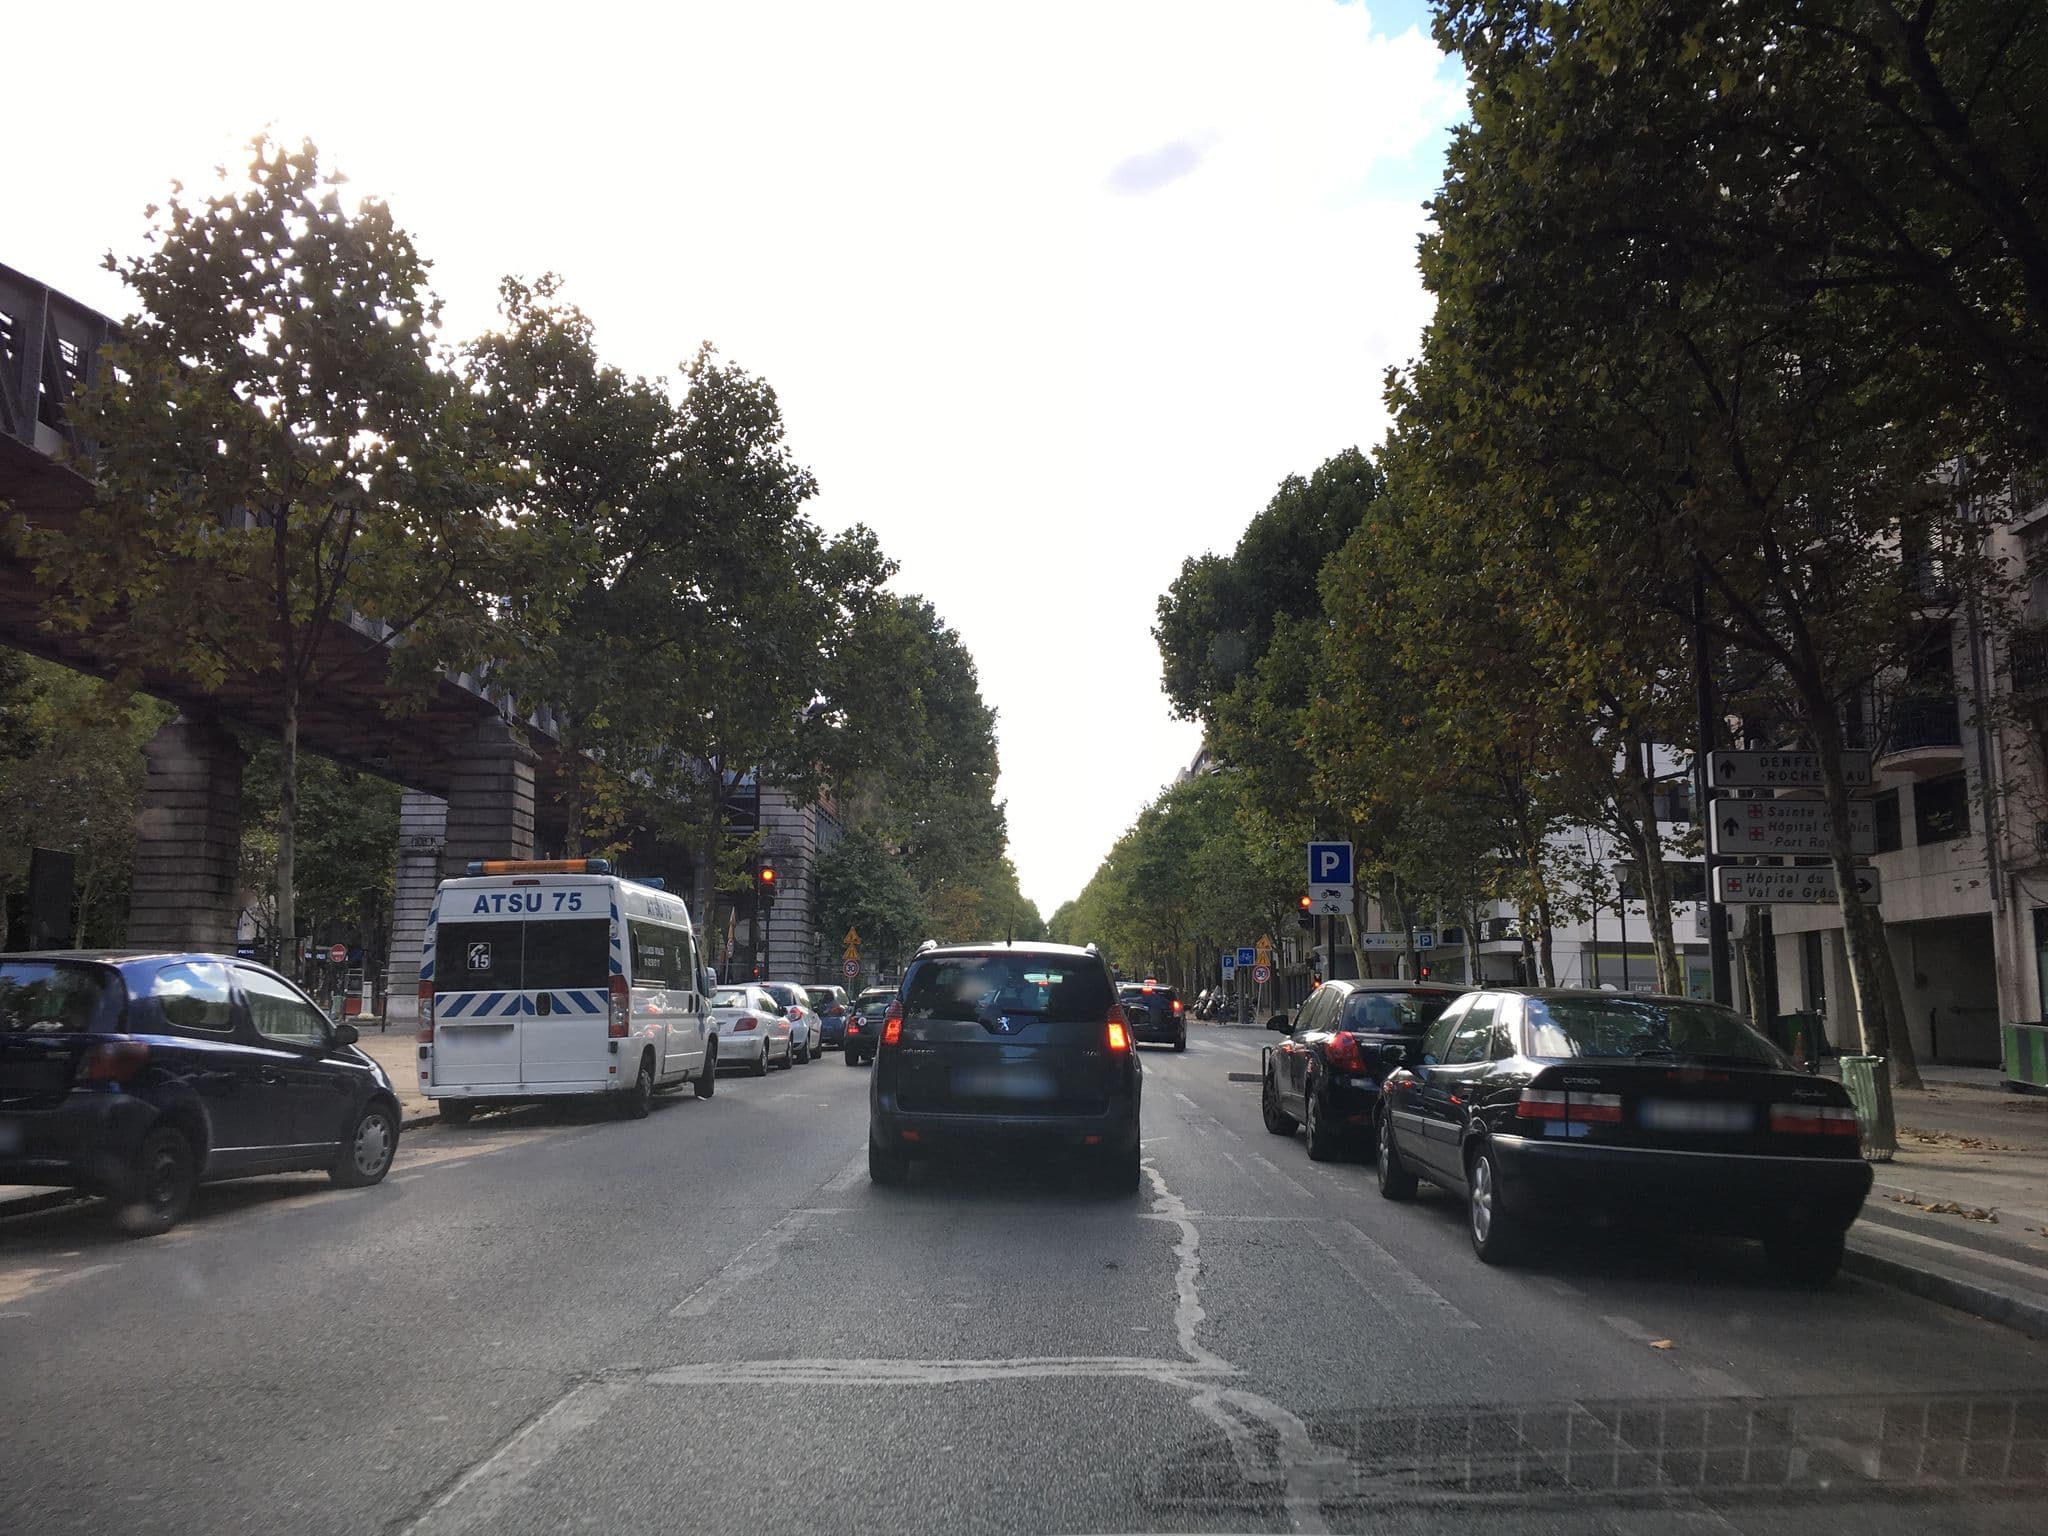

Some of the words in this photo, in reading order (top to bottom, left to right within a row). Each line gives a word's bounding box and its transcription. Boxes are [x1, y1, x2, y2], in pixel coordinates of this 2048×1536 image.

[1759, 756, 1820, 768] DENFE
[1761, 770, 1866, 782] -ROCHEAU
[1767, 806, 1816, 818] Sainte
[1768, 820, 1818, 835] Hôpital
[1823, 822, 1871, 833] Chin
[1320, 851, 1340, 878] P
[1746, 872, 1799, 889] Hôpital
[1807, 872, 1824, 884] du
[1748, 887, 1770, 898] Val
[1777, 887, 1793, 898] de
[1802, 887, 1835, 898] Grâc
[473, 893, 543, 914] ATSU
[552, 891, 582, 912] 75
[472, 954, 489, 968] 15
[847, 964, 856, 972] 30
